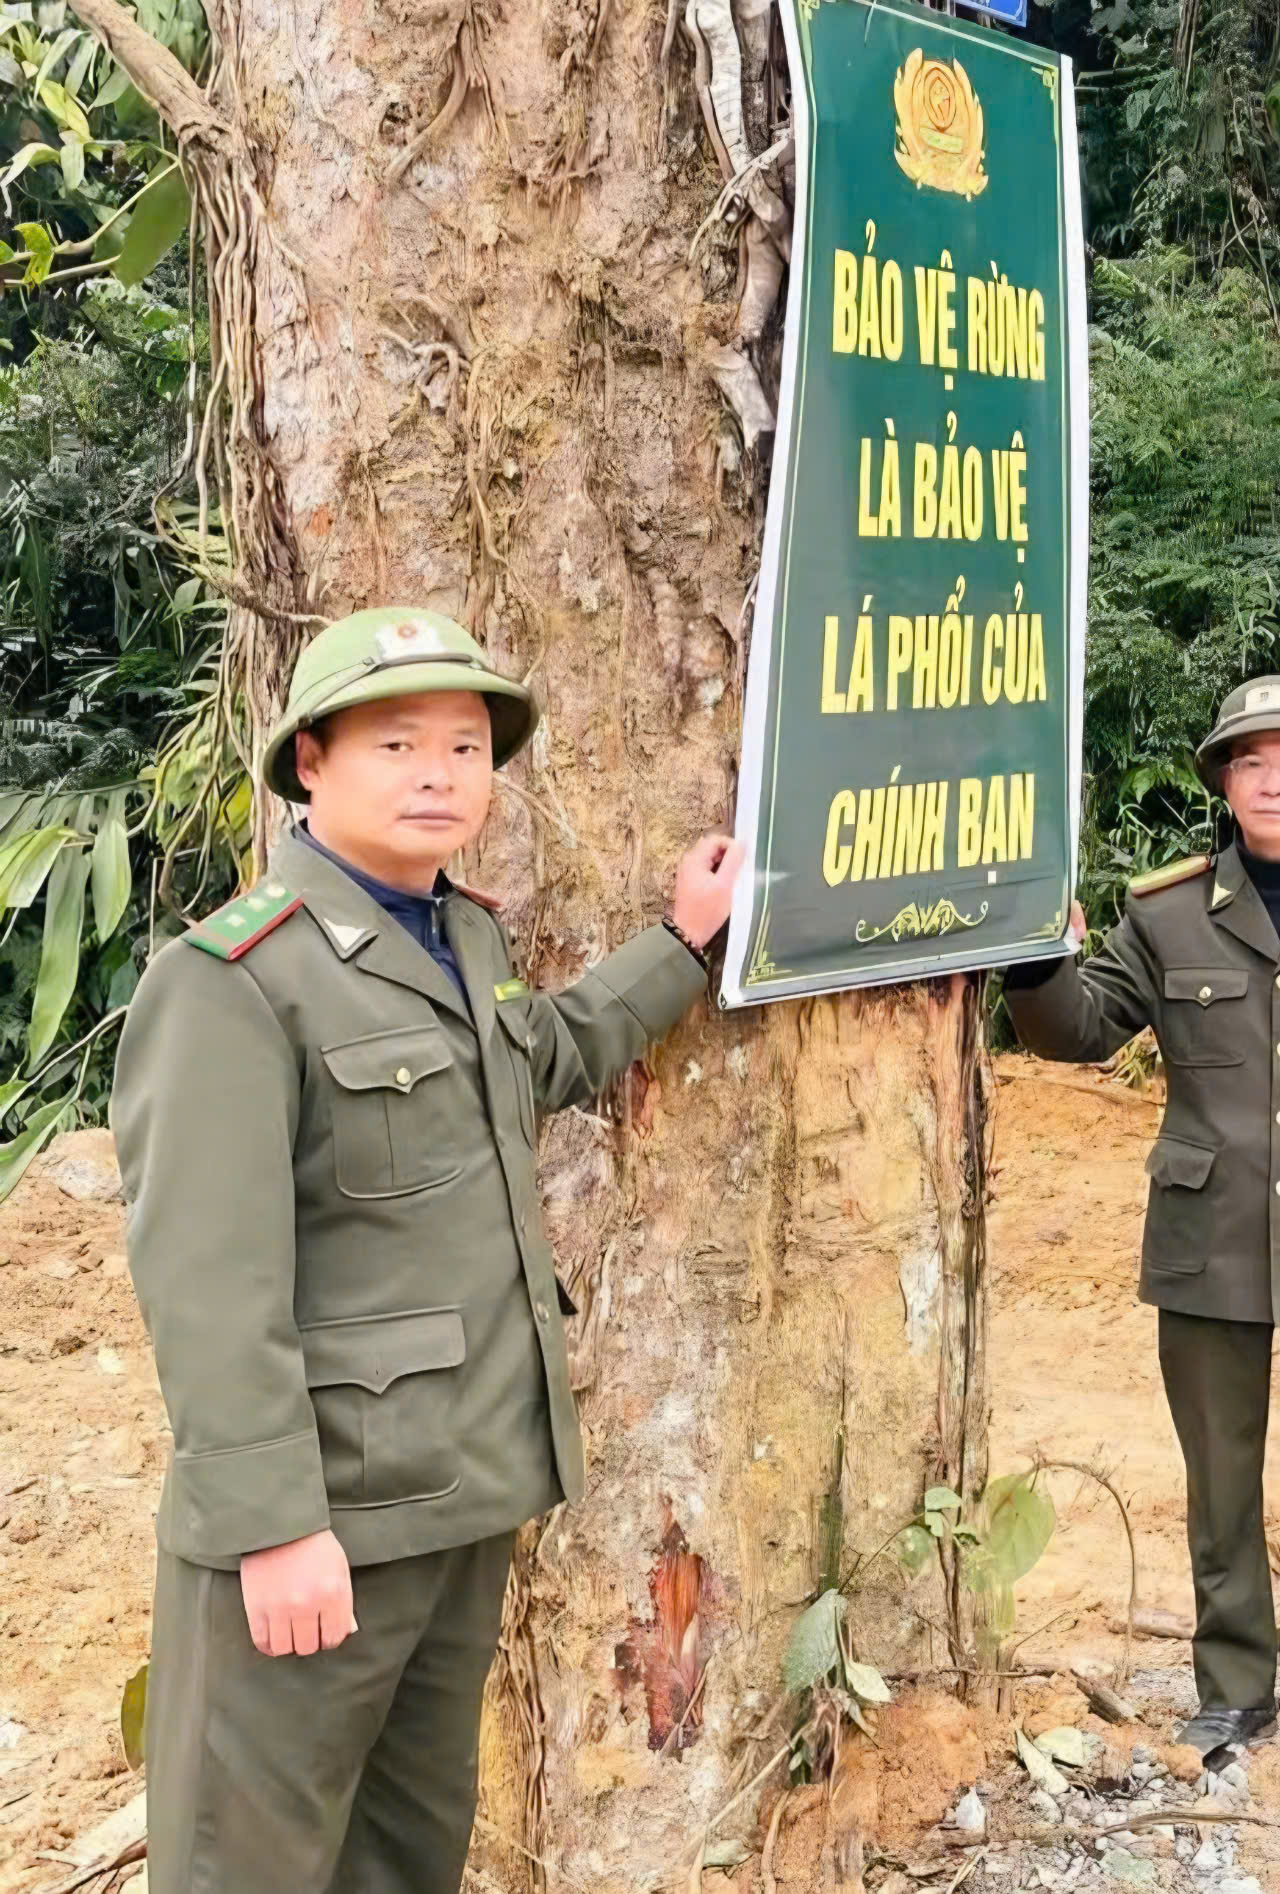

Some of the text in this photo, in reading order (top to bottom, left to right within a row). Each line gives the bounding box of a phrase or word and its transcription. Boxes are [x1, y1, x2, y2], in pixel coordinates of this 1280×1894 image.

[832, 219, 1045, 390] BẢO VỆ RỪNG
[858, 411, 1029, 563] LÀ BẢO VỆ
[821, 575, 1047, 714] LÁ PHỔI CỦA
[822, 766, 1036, 888] CHÍNH BẠN
